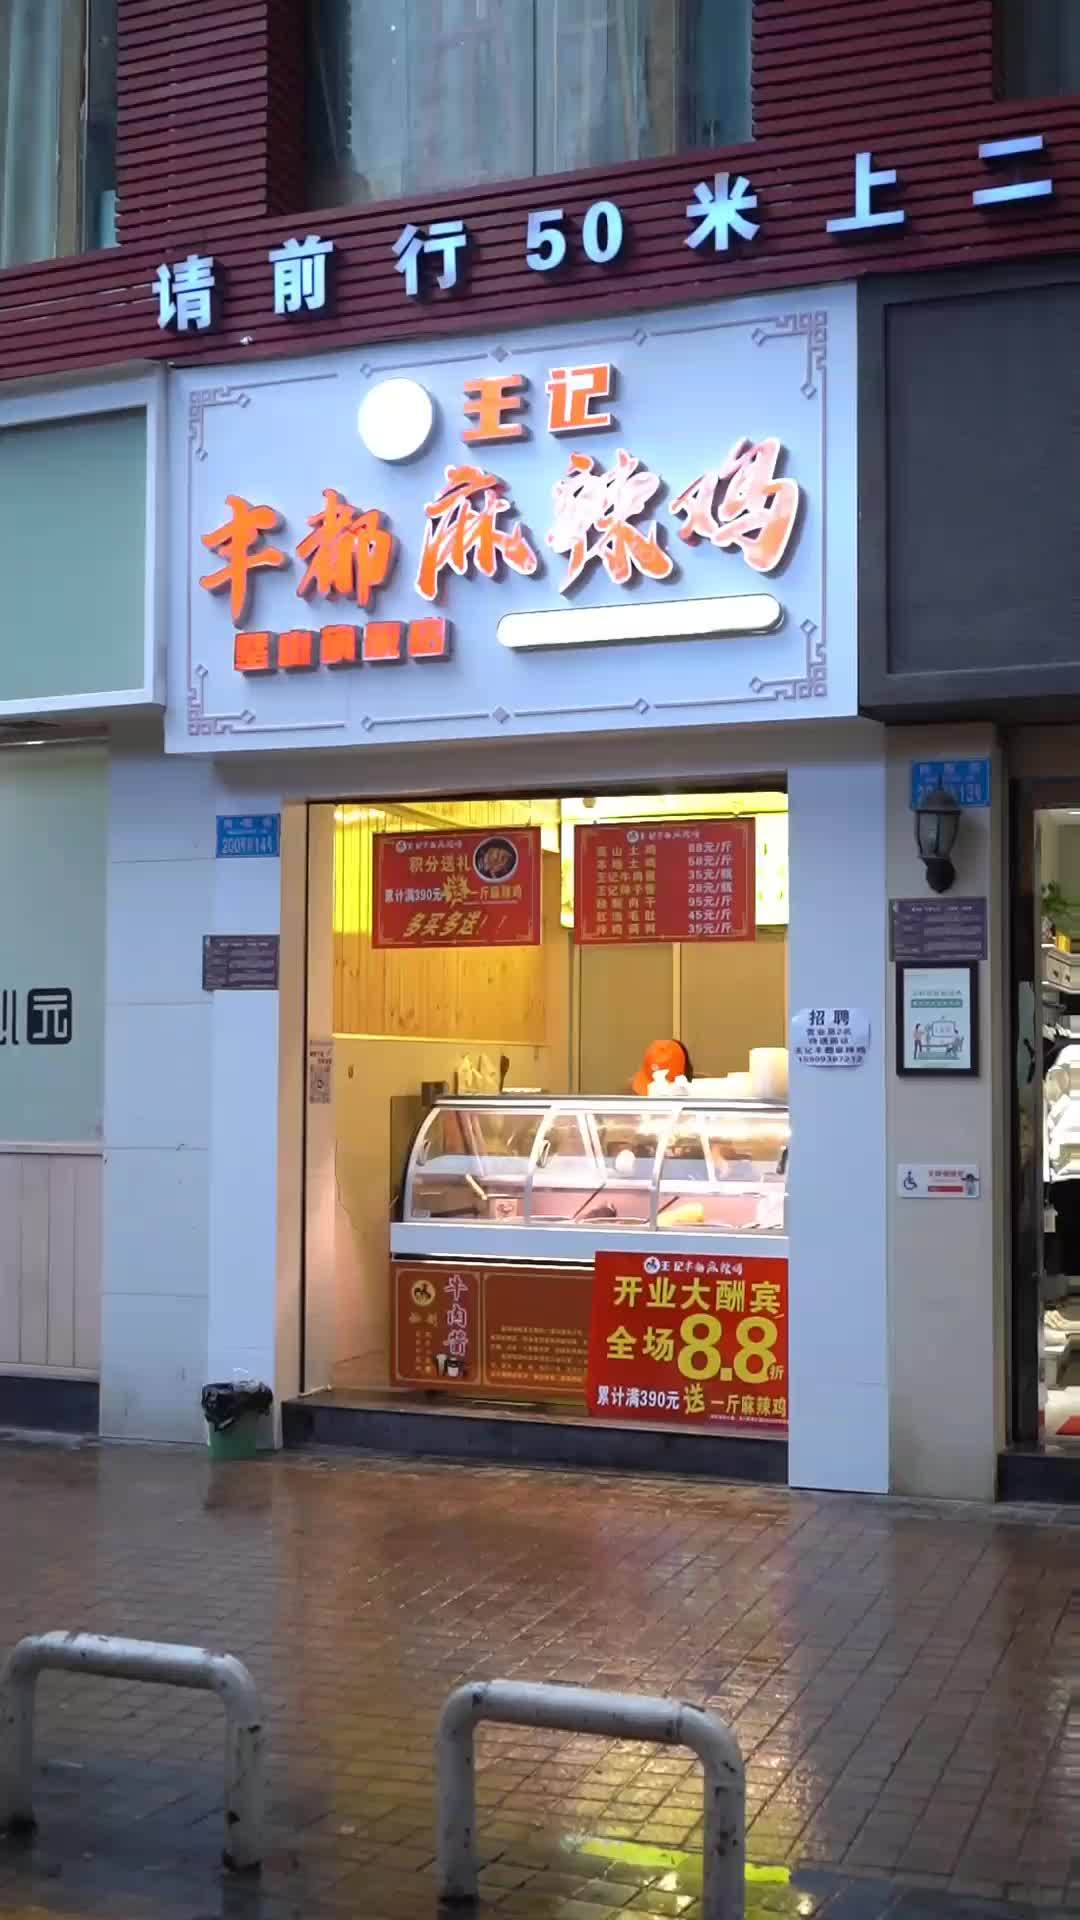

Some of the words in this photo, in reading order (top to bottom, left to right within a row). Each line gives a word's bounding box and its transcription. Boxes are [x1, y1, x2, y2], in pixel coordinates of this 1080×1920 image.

[462, 363, 616, 445] 王记
[200, 437, 803, 624] 丰都麻辣鸡
[808, 1009, 850, 1026] 招聘
[612, 1275, 781, 1314] 开业大酬宾
